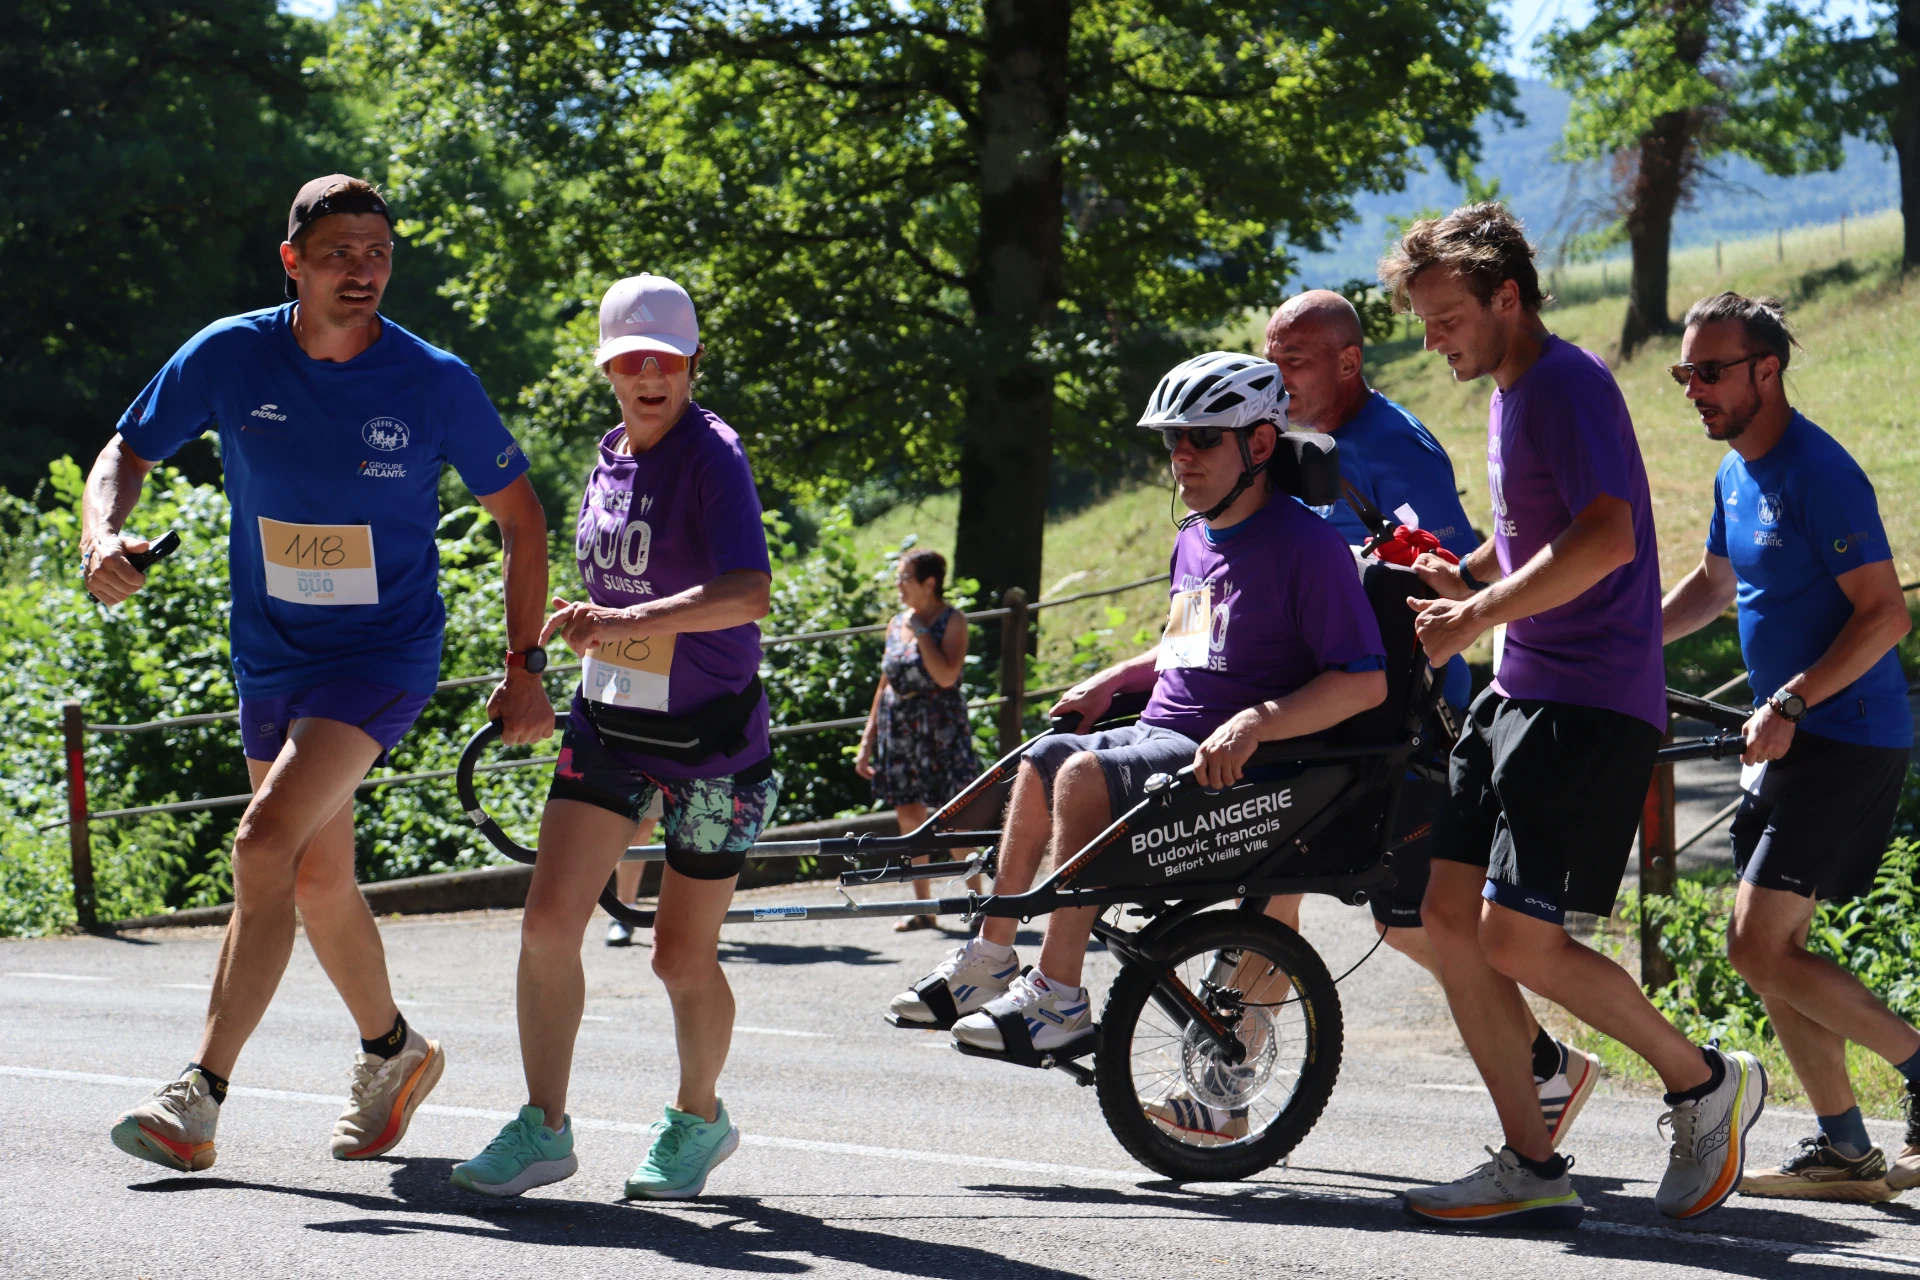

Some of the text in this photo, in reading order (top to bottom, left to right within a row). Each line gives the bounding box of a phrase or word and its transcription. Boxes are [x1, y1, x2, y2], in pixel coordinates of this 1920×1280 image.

[251, 409, 287, 422] eldera
[394, 422, 403, 433] 90
[362, 468, 407, 478] ATLANTIC
[368, 461, 403, 471] GROUPE
[284, 533, 346, 566] 118
[297, 577, 334, 593] DUO
[602, 573, 654, 596] SUISSE
[1131, 788, 1292, 855] BOULANGERIE
[1148, 818, 1280, 867] Ludovic francois
[1164, 838, 1268, 877] Belfort Vieille Ville
[1525, 897, 1556, 911] orca
